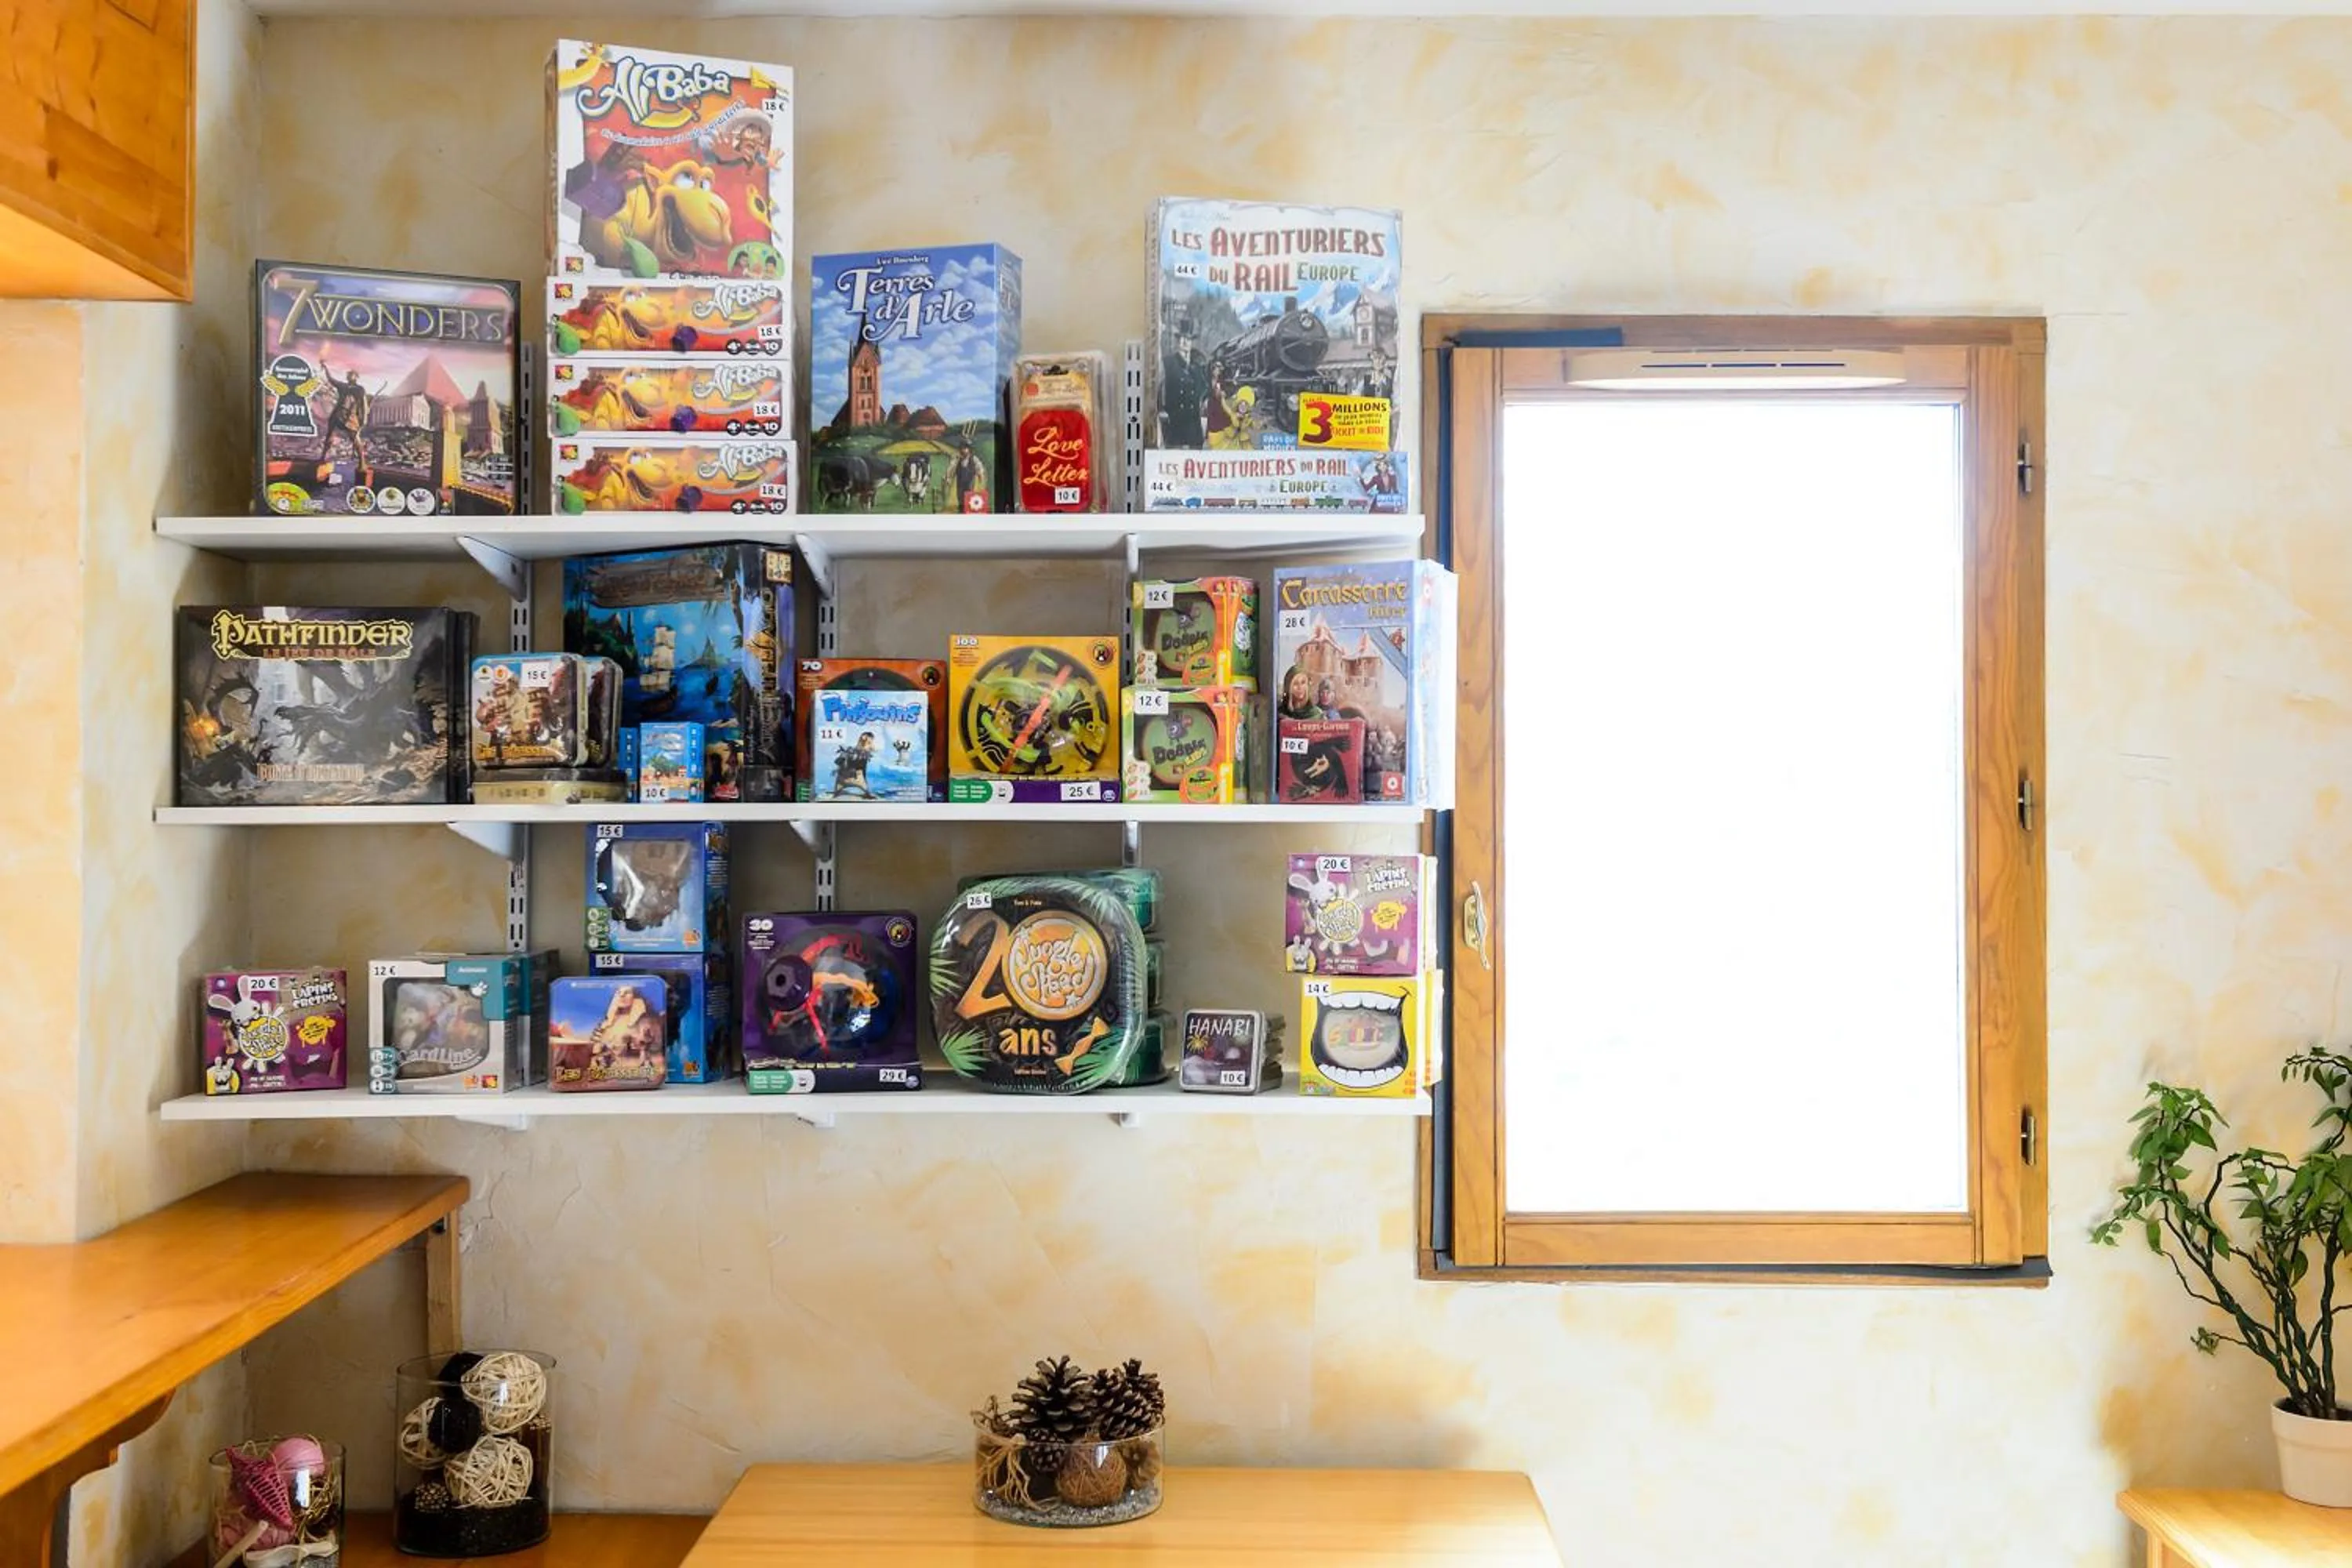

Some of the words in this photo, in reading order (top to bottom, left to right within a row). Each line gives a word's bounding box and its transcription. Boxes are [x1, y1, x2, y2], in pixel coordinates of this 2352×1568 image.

[1171, 229, 1203, 250] LES
[1210, 227, 1386, 258] AVENTURIERS
[1176, 265, 1189, 276] 44
[1297, 260, 1359, 282] EUROPE
[1209, 266, 1229, 285] DU
[1234, 262, 1298, 292] RAIL
[837, 267, 935, 315] Terres
[307, 296, 503, 341] WONDERS
[862, 289, 975, 342] d'Arle
[760, 327, 772, 336] 18
[279, 404, 306, 416] 2011
[756, 405, 768, 415] 18
[1302, 401, 1334, 445] 3
[1332, 402, 1387, 413] MILLIONS
[1027, 426, 1083, 461] Love
[1023, 456, 1088, 487] Letter
[1159, 462, 1179, 476] LES
[1183, 458, 1296, 479] AVENTURIERS
[1316, 458, 1348, 477] RAIL
[762, 485, 774, 495] 18
[1150, 481, 1164, 492] 44
[1279, 479, 1328, 494] EUROPE
[1058, 491, 1069, 501] 10
[1148, 591, 1160, 602] 12
[213, 612, 412, 657] PATHFINDER
[527, 670, 539, 680] 15
[540, 670, 548, 680] €
[1139, 695, 1154, 707] 12
[1155, 695, 1162, 706] €
[820, 730, 833, 739] 11
[1284, 741, 1296, 750] 10
[645, 787, 657, 798] 10
[1069, 786, 1083, 798] 25
[1085, 785, 1094, 797] €
[599, 826, 612, 837] 15
[613, 826, 621, 837] €
[1323, 858, 1338, 870] 20
[1340, 858, 1348, 869] €
[601, 956, 614, 966] 15
[614, 955, 622, 966] €
[373, 965, 387, 976] 12
[389, 965, 397, 976] €
[250, 978, 266, 989] 20
[268, 978, 277, 989] €
[1307, 984, 1319, 993] 14
[1323, 984, 1330, 993] €
[1189, 1018, 1250, 1036] HANABI
[998, 1027, 1058, 1057] ans
[881, 1070, 895, 1080] 29
[897, 1071, 905, 1081] €
[1223, 1073, 1235, 1083] 10
